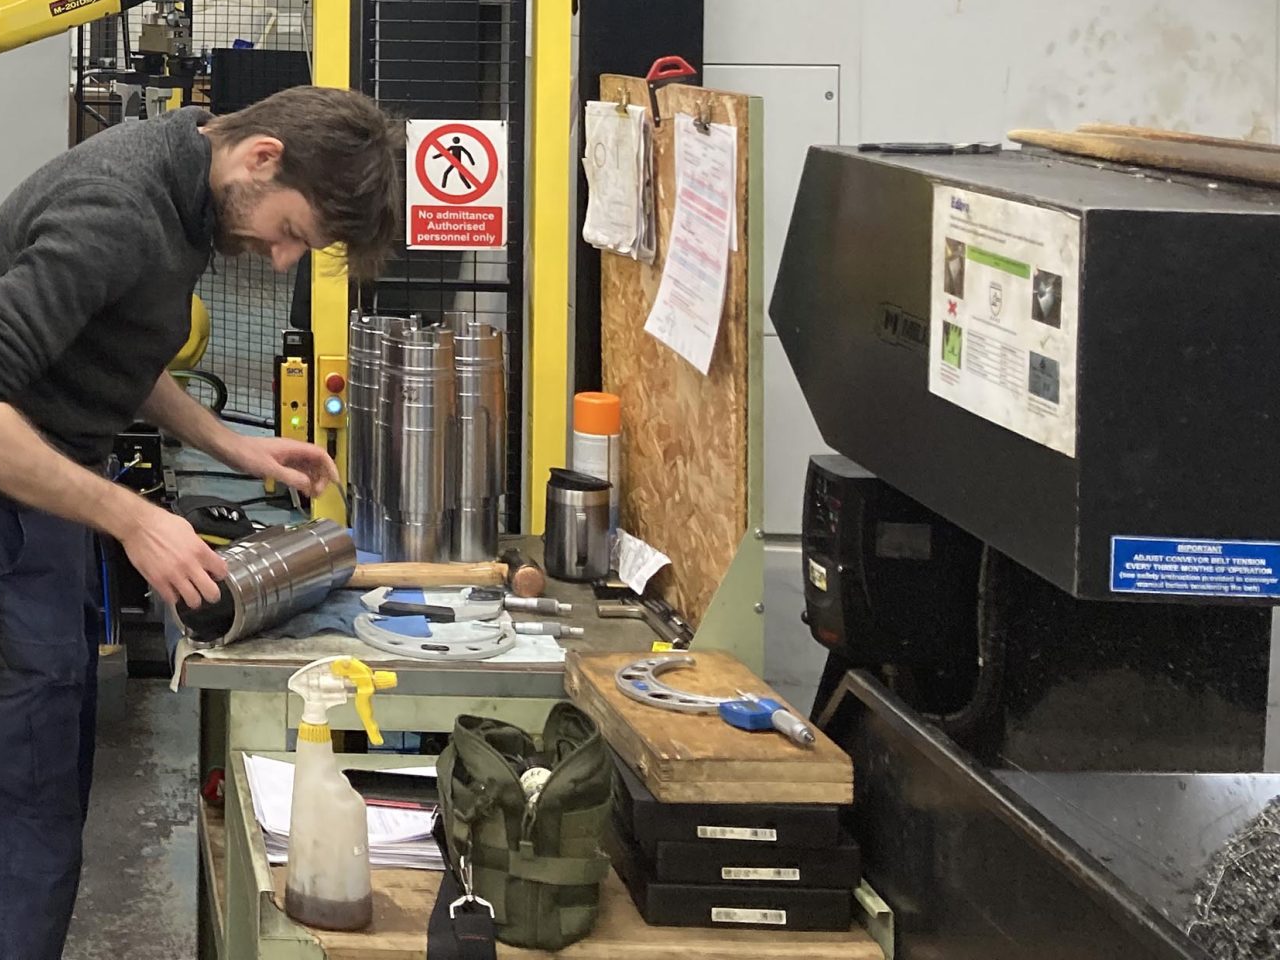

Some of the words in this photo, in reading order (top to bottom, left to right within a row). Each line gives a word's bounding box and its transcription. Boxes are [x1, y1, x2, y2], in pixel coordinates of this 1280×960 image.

[418, 210, 434, 219] No
[436, 210, 495, 221] admittance
[427, 221, 486, 231] Authorised
[417, 233, 470, 243] personnel
[472, 233, 496, 244] only
[1177, 544, 1223, 554] IMPORTANT
[1133, 554, 1163, 563] ADJUST
[1165, 555, 1209, 564] CONVEYOR
[1211, 557, 1230, 565] BELT
[1232, 558, 1266, 566] TENSION
[1126, 562, 1152, 571] EVERY
[1153, 564, 1179, 572] THREE
[1180, 565, 1214, 573] MONTHS
[1215, 566, 1226, 574] OF
[1228, 566, 1273, 575] OPERATION
